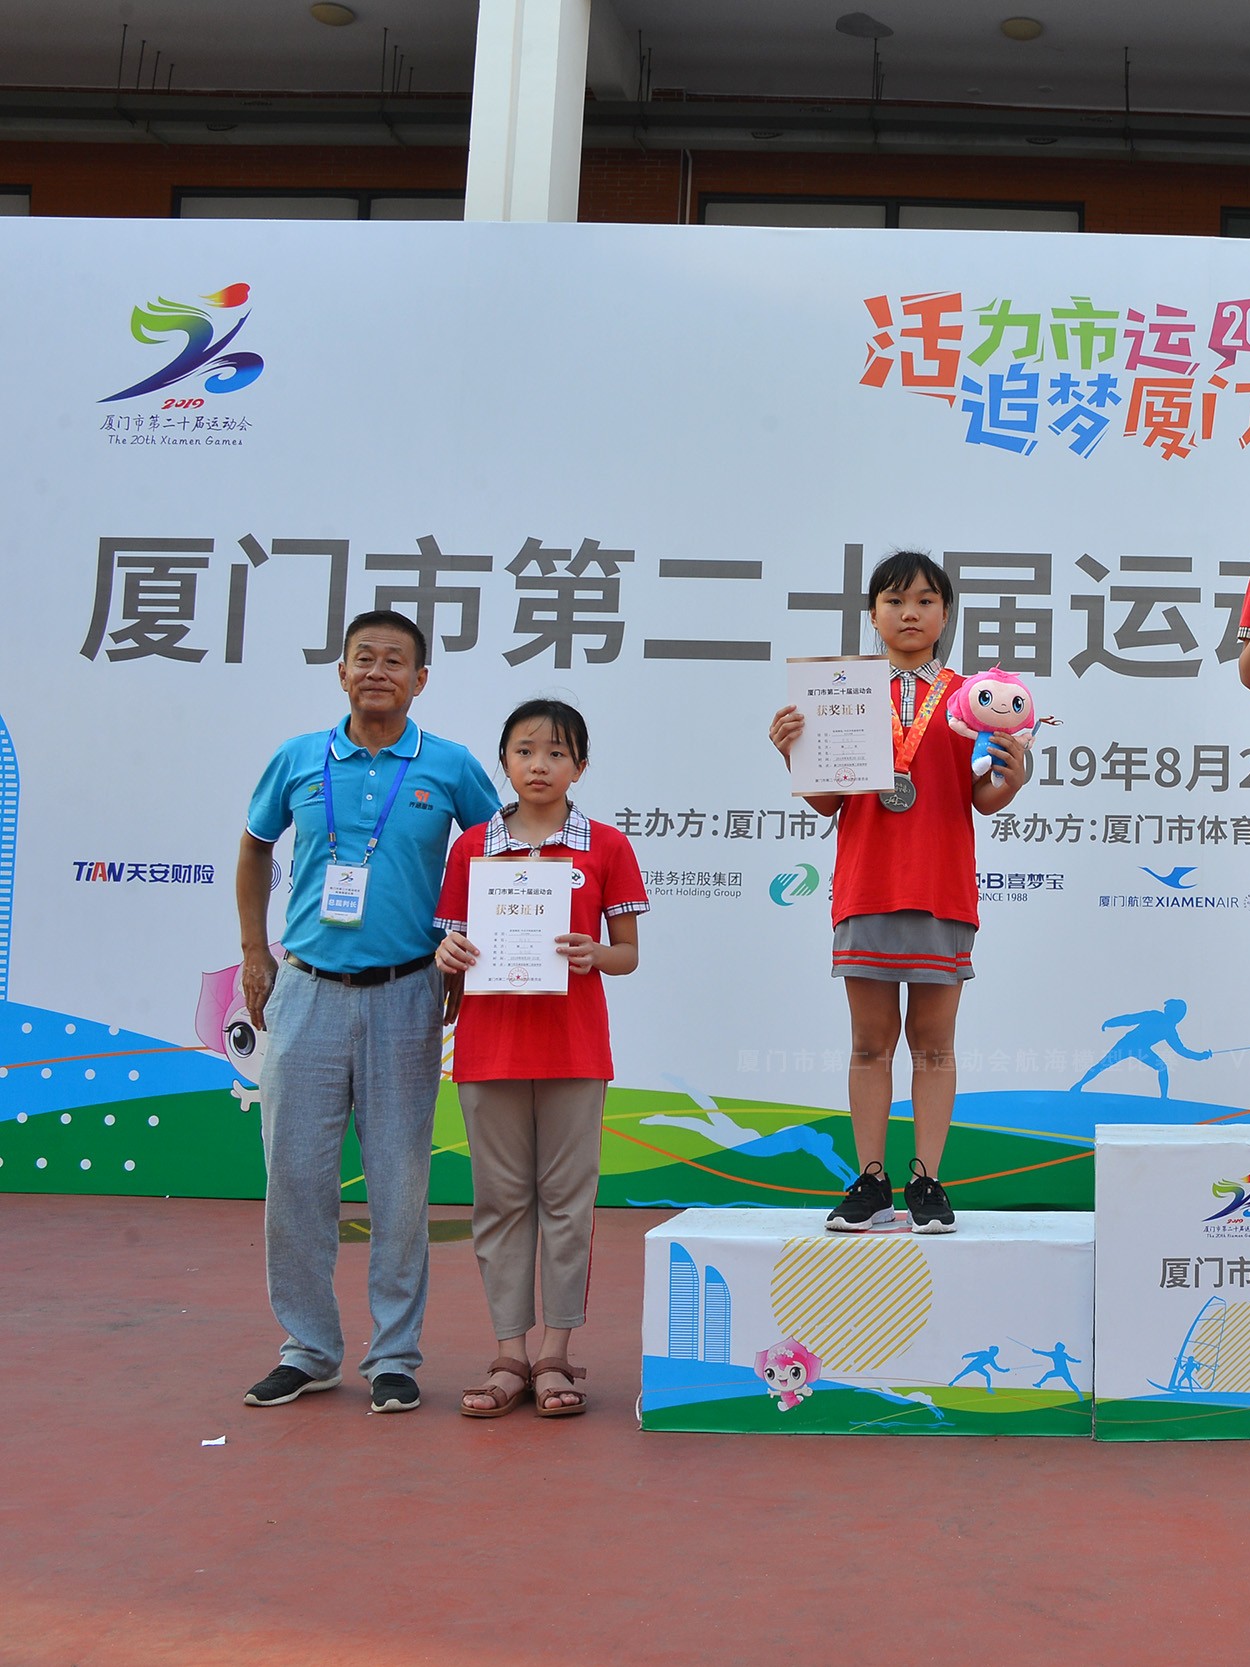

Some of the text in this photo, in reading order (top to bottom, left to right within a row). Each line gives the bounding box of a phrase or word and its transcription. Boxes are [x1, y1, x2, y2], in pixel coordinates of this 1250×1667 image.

[859, 290, 1200, 408] 活力市运
[161, 398, 205, 410] 2019
[100, 414, 253, 432] 厦门市第二十届运动会
[108, 434, 127, 445] The
[130, 435, 157, 445] 20th
[807, 687, 873, 697] 厦门市第二十届运动会
[126, 862, 215, 884] 天安财险
[1008, 873, 1064, 890] 喜梦宝
[487, 888, 553, 896] 厦门市第二十届运动会
[676, 888, 711, 898] Holding
[714, 889, 742, 898] Group
[1007, 893, 1028, 902] 1988
